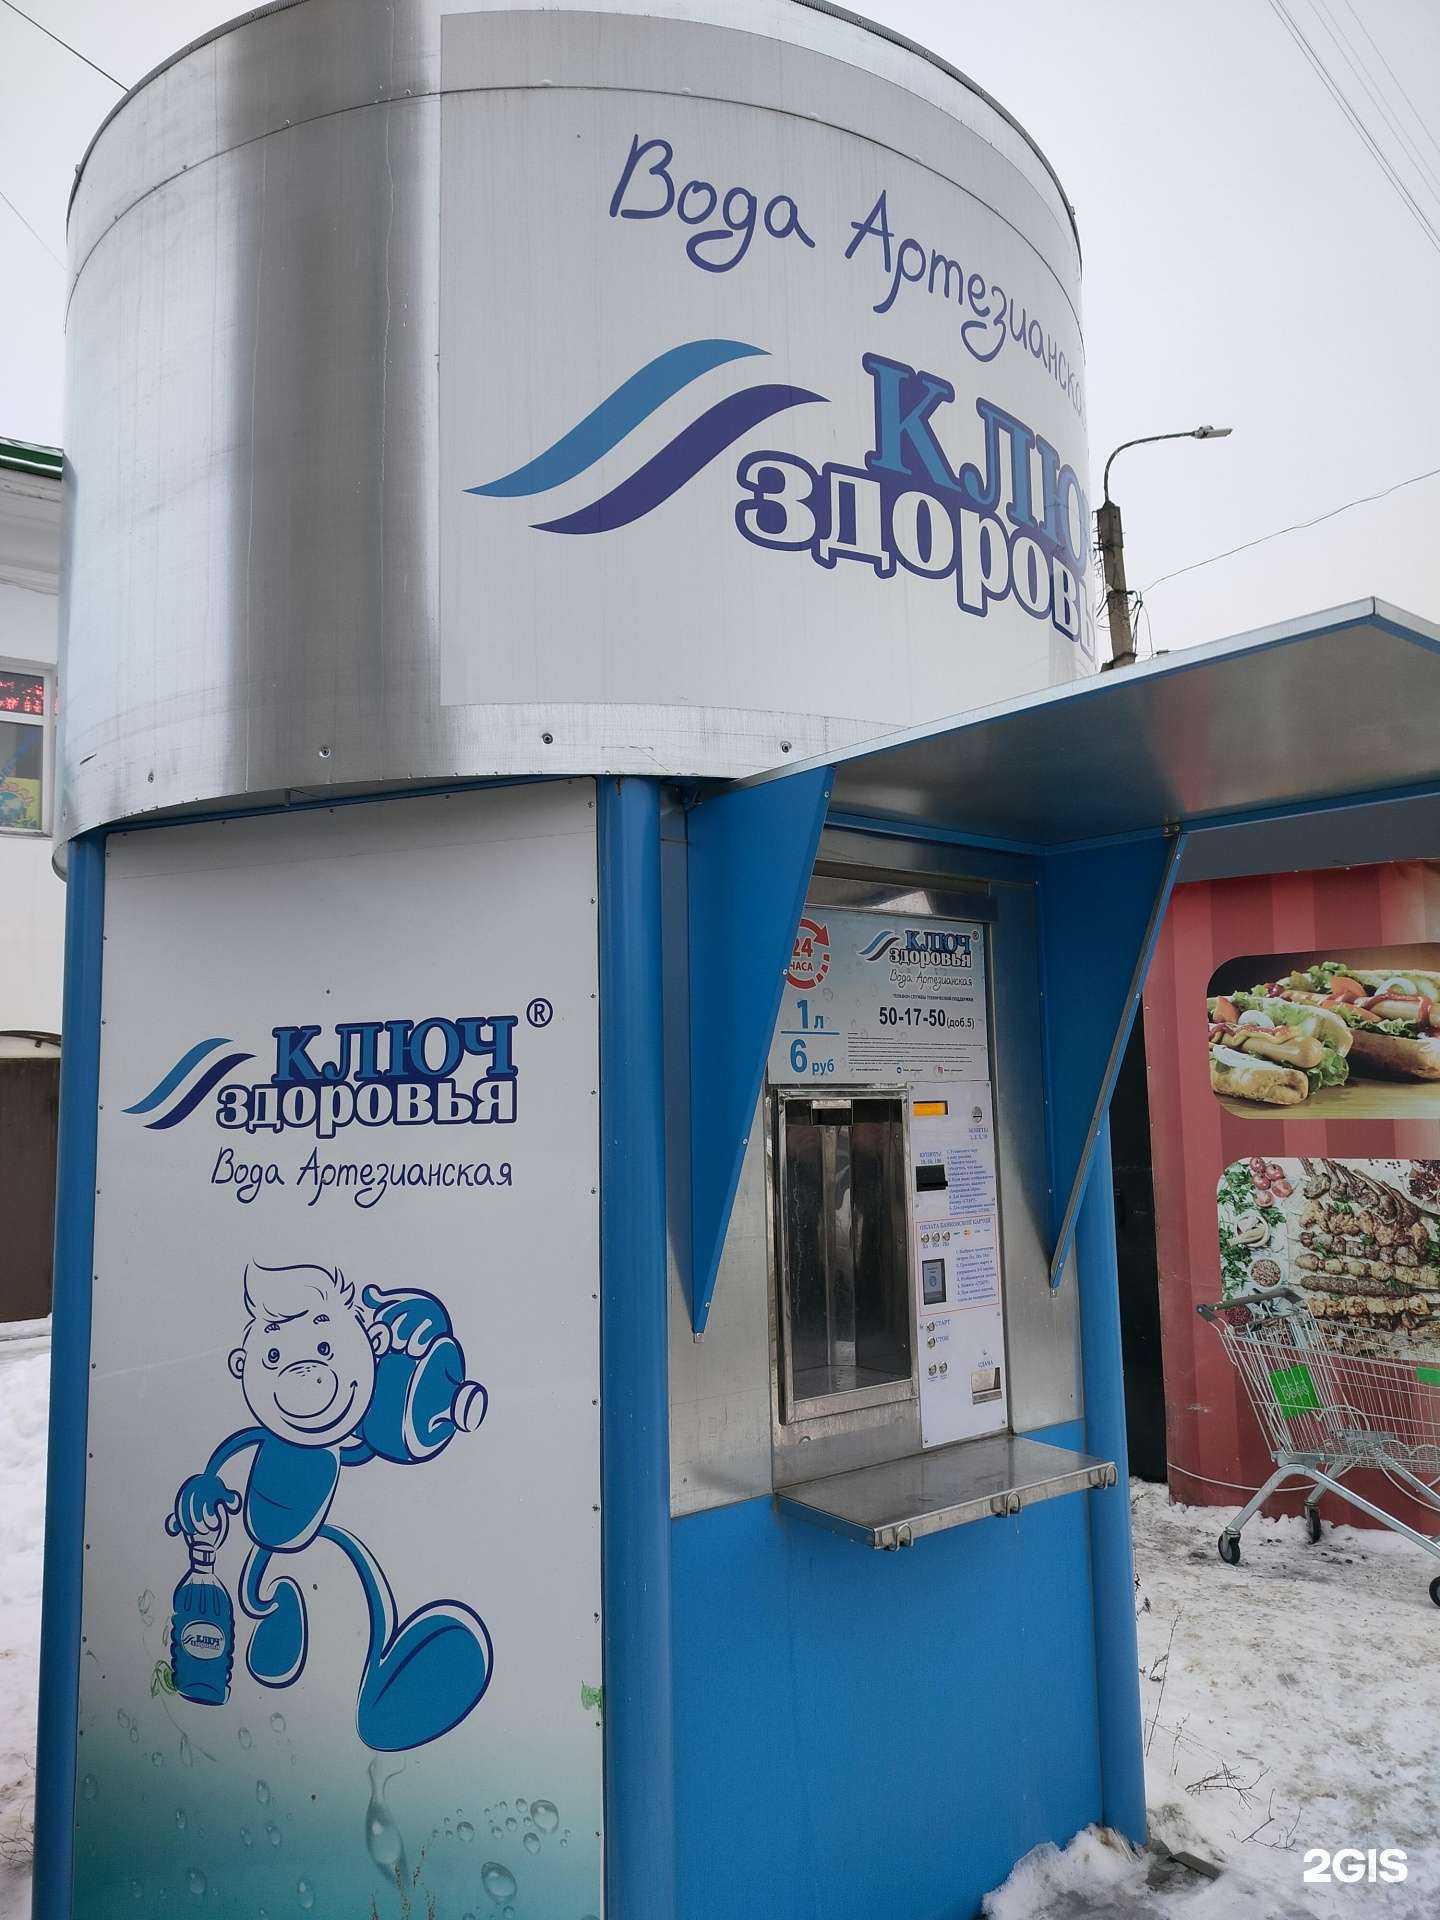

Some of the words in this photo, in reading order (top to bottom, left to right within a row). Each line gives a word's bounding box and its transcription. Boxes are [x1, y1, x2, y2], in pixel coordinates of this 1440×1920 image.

[609, 133, 816, 273] Вода
[844, 189, 1088, 434] Артезианска
[862, 352, 1091, 572] КЛЮ
[905, 929, 971, 952] КЛЮЧ
[889, 969, 913, 988] Вода
[916, 970, 973, 991] Артезианская
[796, 999, 809, 1029] 1
[813, 1014, 824, 1030] л
[879, 1006, 946, 1027] 50-17-50
[272, 1015, 518, 1083] КЛЮЧ
[790, 1039, 808, 1073] 6
[811, 1058, 835, 1076] руб
[211, 1147, 285, 1204] Вода
[296, 1147, 513, 1209] Артезианская
